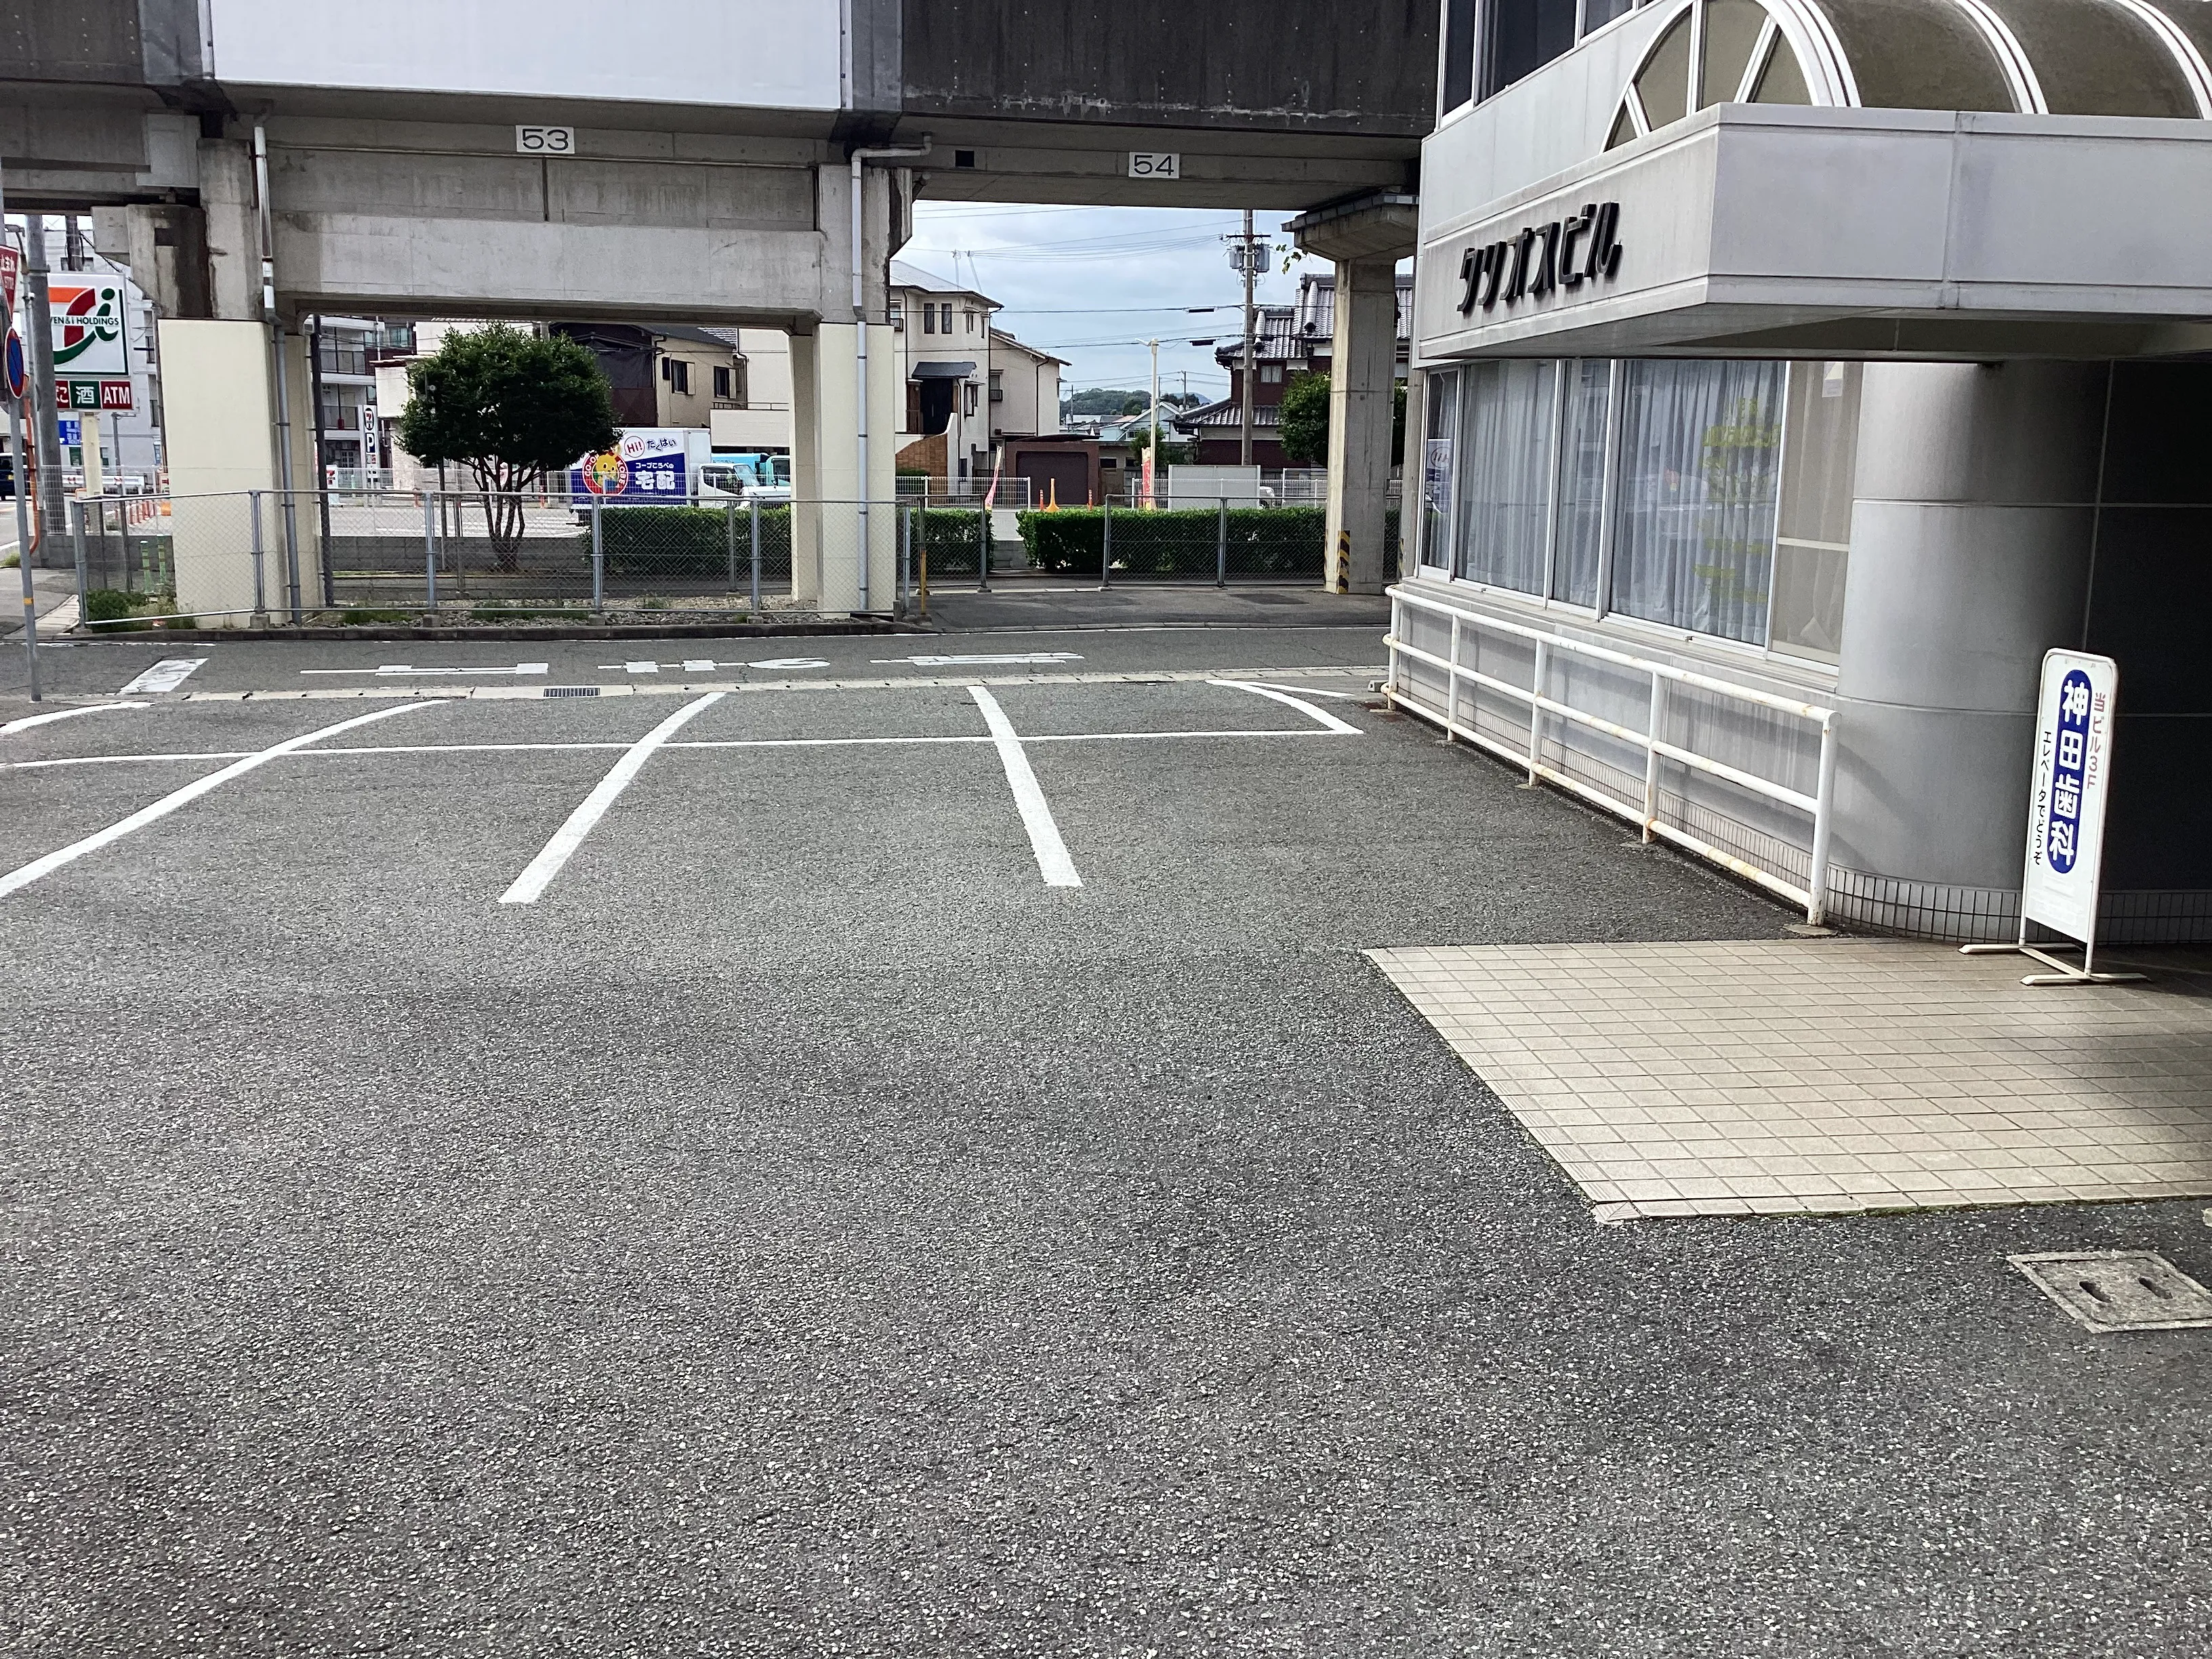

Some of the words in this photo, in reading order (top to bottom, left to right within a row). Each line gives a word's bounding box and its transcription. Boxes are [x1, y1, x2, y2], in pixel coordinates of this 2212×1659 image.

[523, 128, 569, 150] 53
[1134, 155, 1174, 176] 54
[77, 316, 119, 325] HOLDINGS
[75, 386, 94, 404] 酒
[103, 386, 131, 404] ATM
[367, 434, 374, 452] P
[627, 441, 643, 453] Hi!
[647, 438, 676, 451] たくはい
[635, 470, 676, 490] 宅配
[2087, 692, 2106, 790] 当ビル3F
[2049, 680, 2089, 866] 神田歯科
[2033, 731, 2052, 865] エレベータでどうぞ
